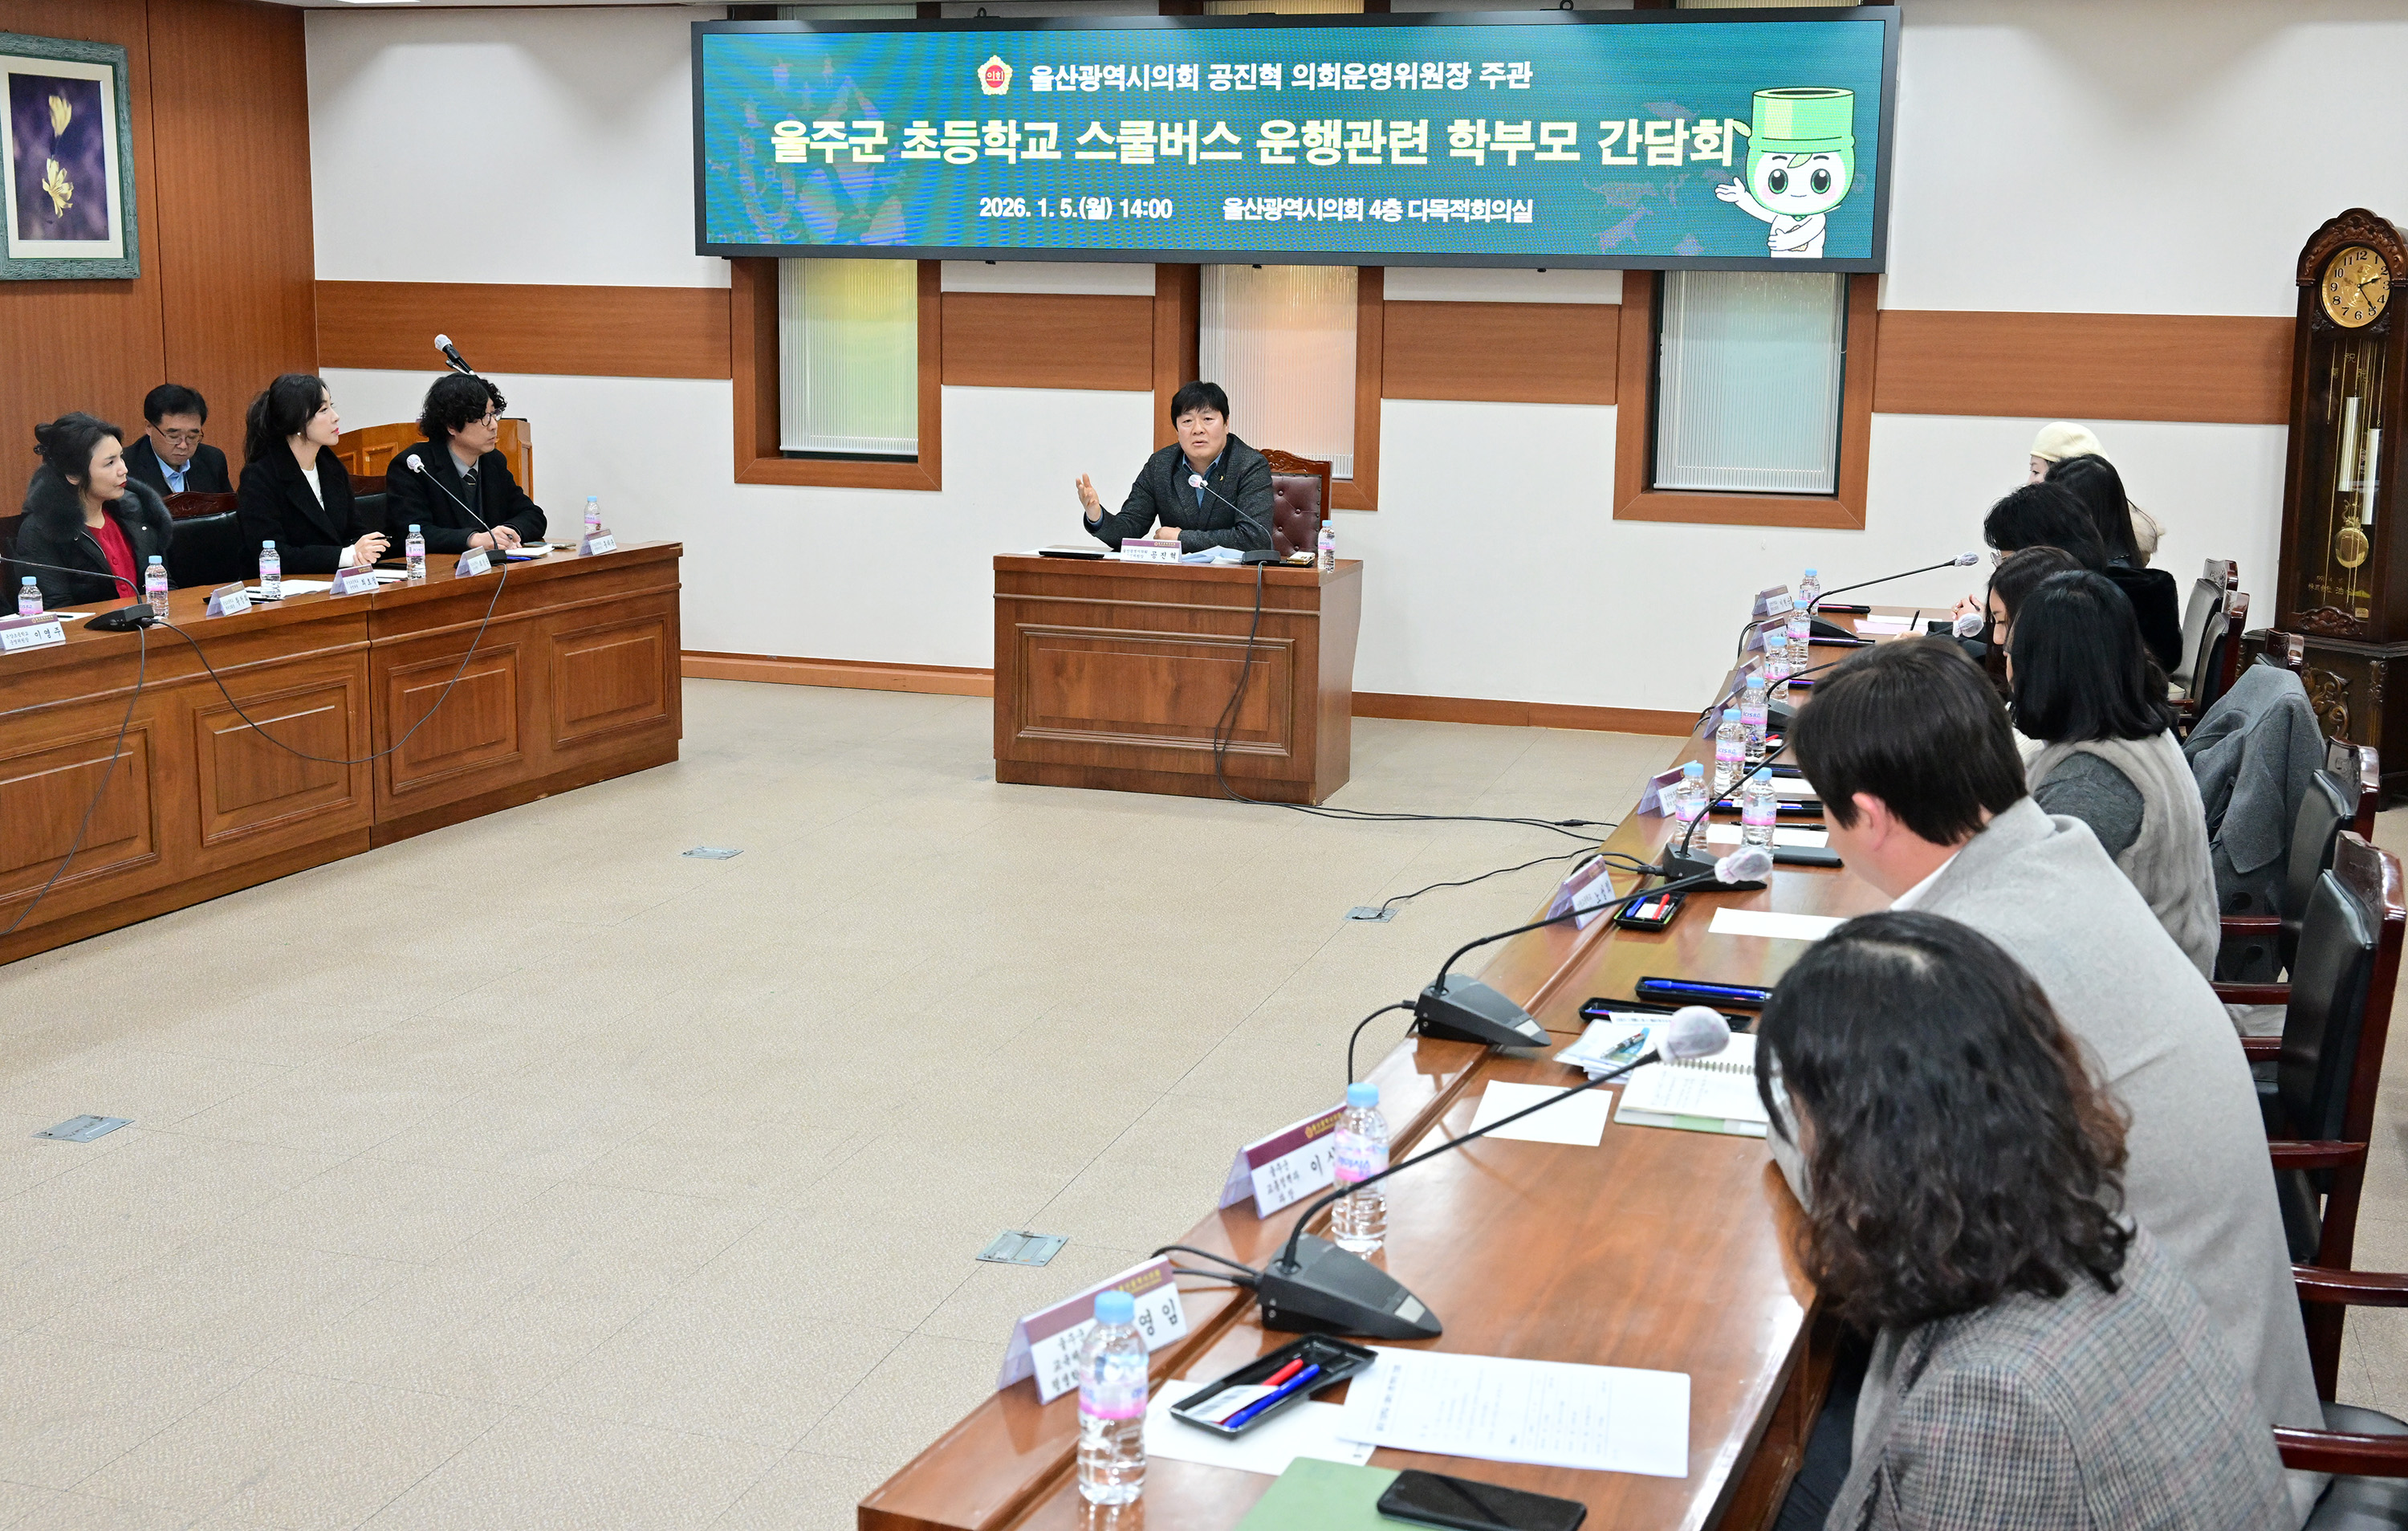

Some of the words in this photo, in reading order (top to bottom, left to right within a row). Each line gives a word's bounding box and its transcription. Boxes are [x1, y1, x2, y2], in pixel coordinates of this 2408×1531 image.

[986, 71, 1004, 82] 의회
[1030, 64, 1199, 92] 울산광역시의회
[1208, 63, 1282, 92] 공진혁
[1291, 62, 1472, 91] 의회운영위원장
[1480, 62, 1534, 90] 주관
[771, 120, 889, 164] 울주군
[900, 120, 1062, 165] 초등학교
[1075, 120, 1243, 165] 스쿨버스
[1256, 119, 1429, 166] 운행관련
[1447, 119, 1581, 166] 학부모
[1597, 118, 1735, 166] 간담회
[979, 197, 1031, 218] 2026.
[1038, 197, 1055, 218] 1.
[1060, 197, 1112, 220] 5.(월)
[1120, 197, 1173, 218] 14:00
[1223, 197, 1364, 222] 울산광역시의회
[1369, 197, 1404, 222] 4층
[1408, 198, 1533, 223] 다목적회의실
[2344, 256, 2353, 266] 11
[2356, 250, 2368, 261] 12
[2375, 254, 2378, 265] 1
[2335, 267, 2343, 278] 10
[2381, 266, 2388, 276] 2
[2331, 282, 2338, 292] 9
[2383, 280, 2390, 291] 3
[2333, 295, 2341, 305] 8
[2377, 294, 2385, 303] 4
[2342, 307, 2349, 316] 7
[2354, 310, 2362, 320] 6
[2369, 306, 2376, 316] 5
[1151, 551, 1177, 560] 공진혁
[35, 626, 61, 639] 이영주
[1139, 1298, 1178, 1336] 영임
